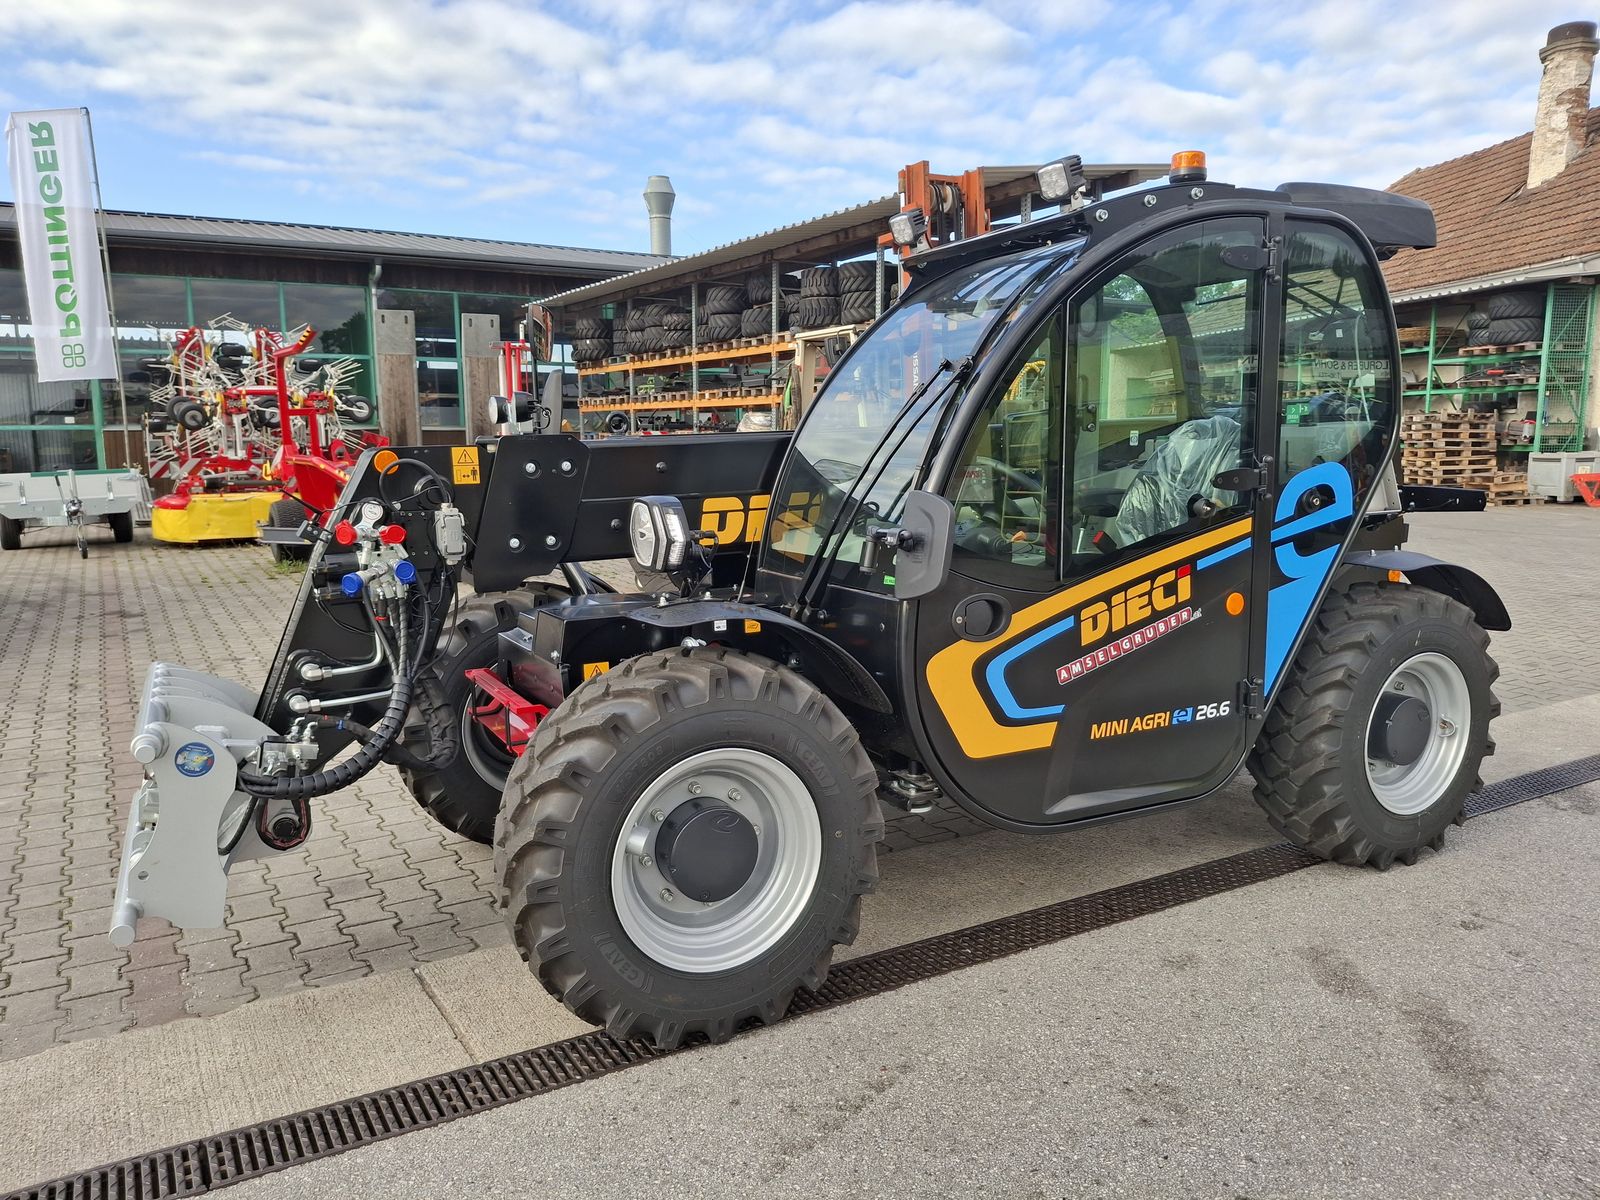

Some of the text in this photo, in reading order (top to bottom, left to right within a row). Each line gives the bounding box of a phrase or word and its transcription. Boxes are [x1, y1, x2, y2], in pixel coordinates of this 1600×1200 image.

[1090, 721, 1127, 739] MINI
[1130, 711, 1170, 732] AGRI
[1195, 701, 1230, 720] 26.6
